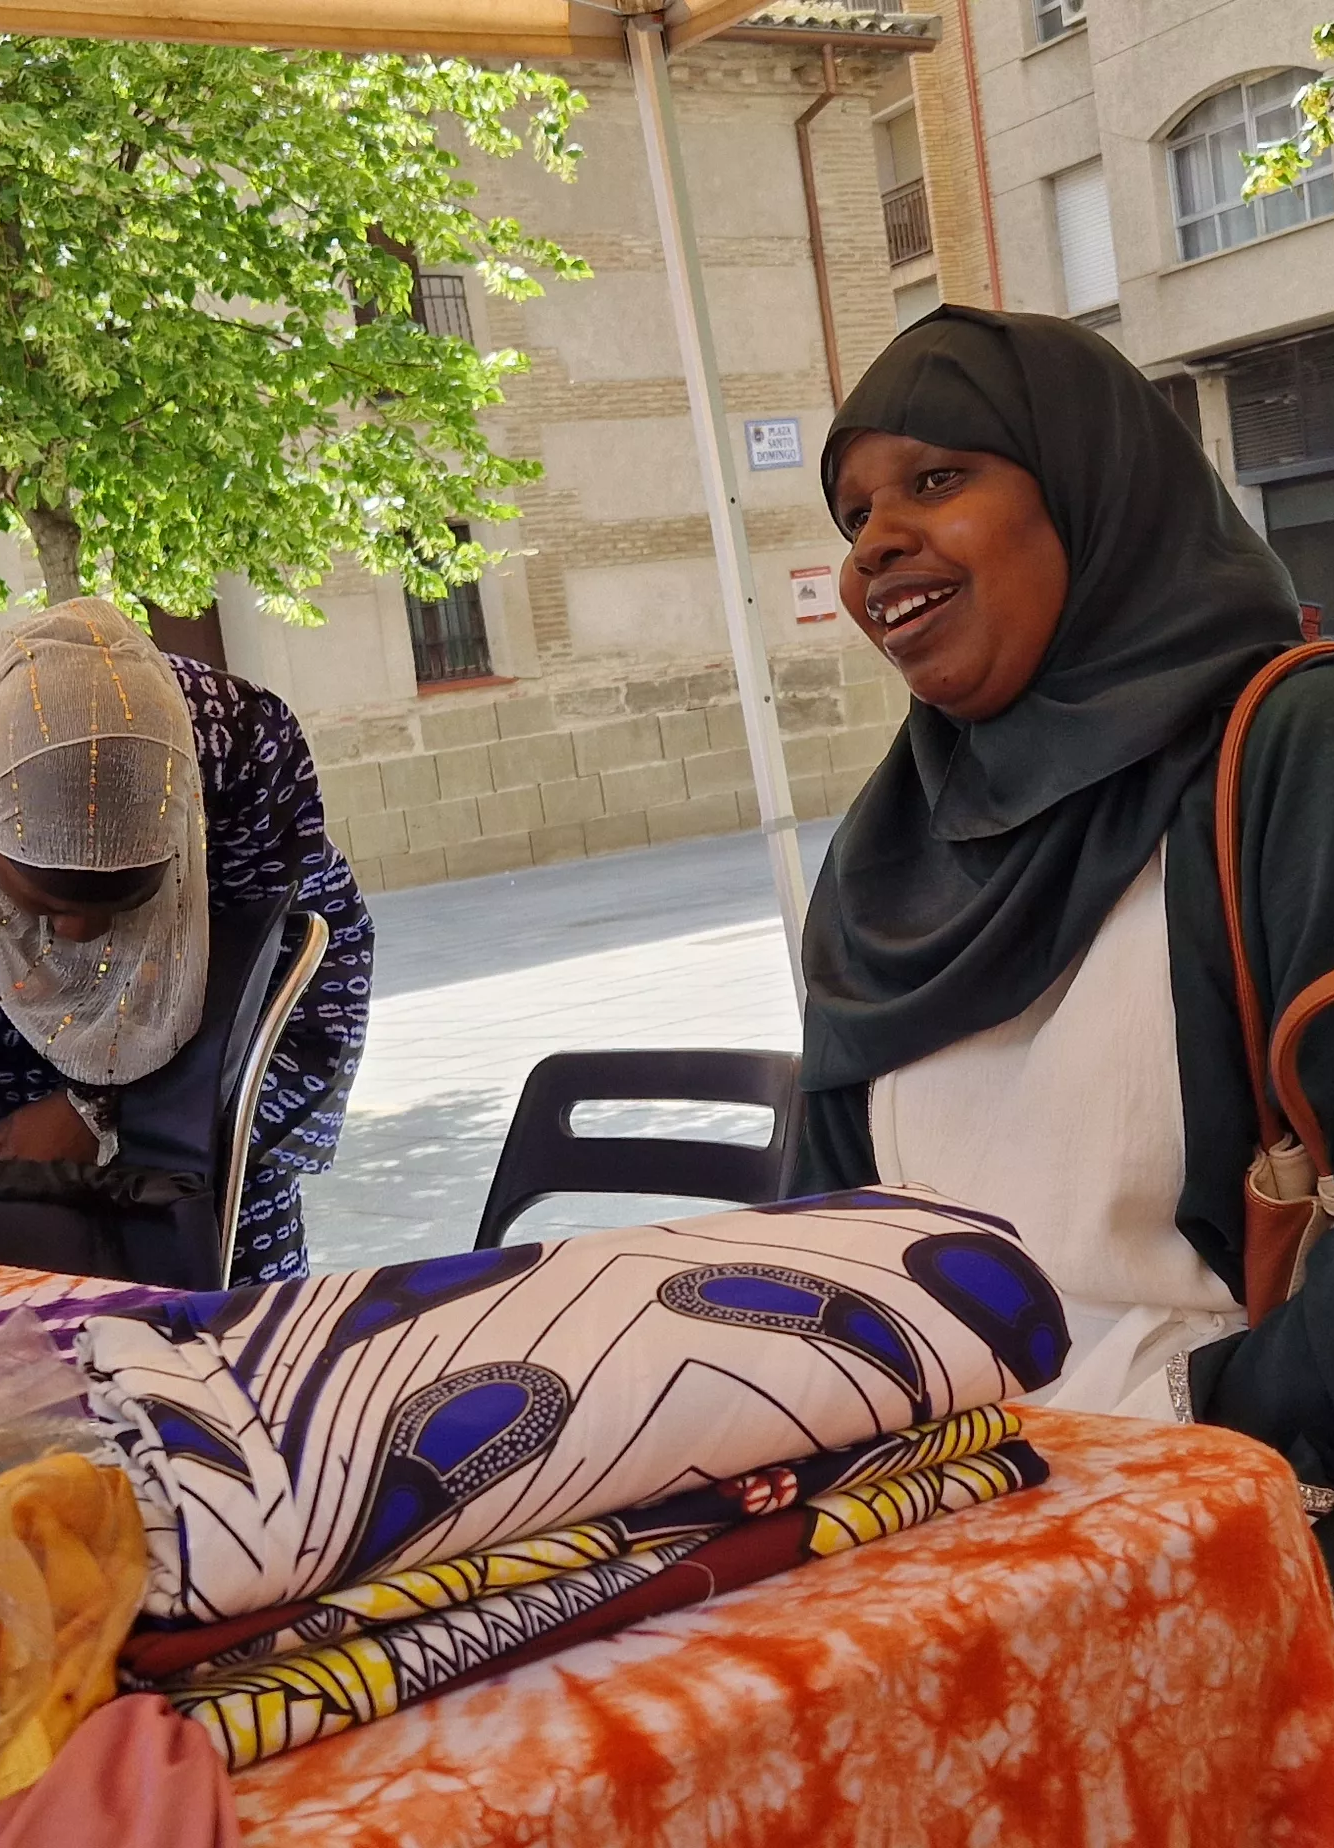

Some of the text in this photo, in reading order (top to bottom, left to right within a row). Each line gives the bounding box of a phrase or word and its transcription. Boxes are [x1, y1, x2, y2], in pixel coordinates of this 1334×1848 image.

[768, 426, 791, 437] PLAZA
[768, 437, 794, 448] SANTO
[757, 449, 796, 462] DOMINGO
